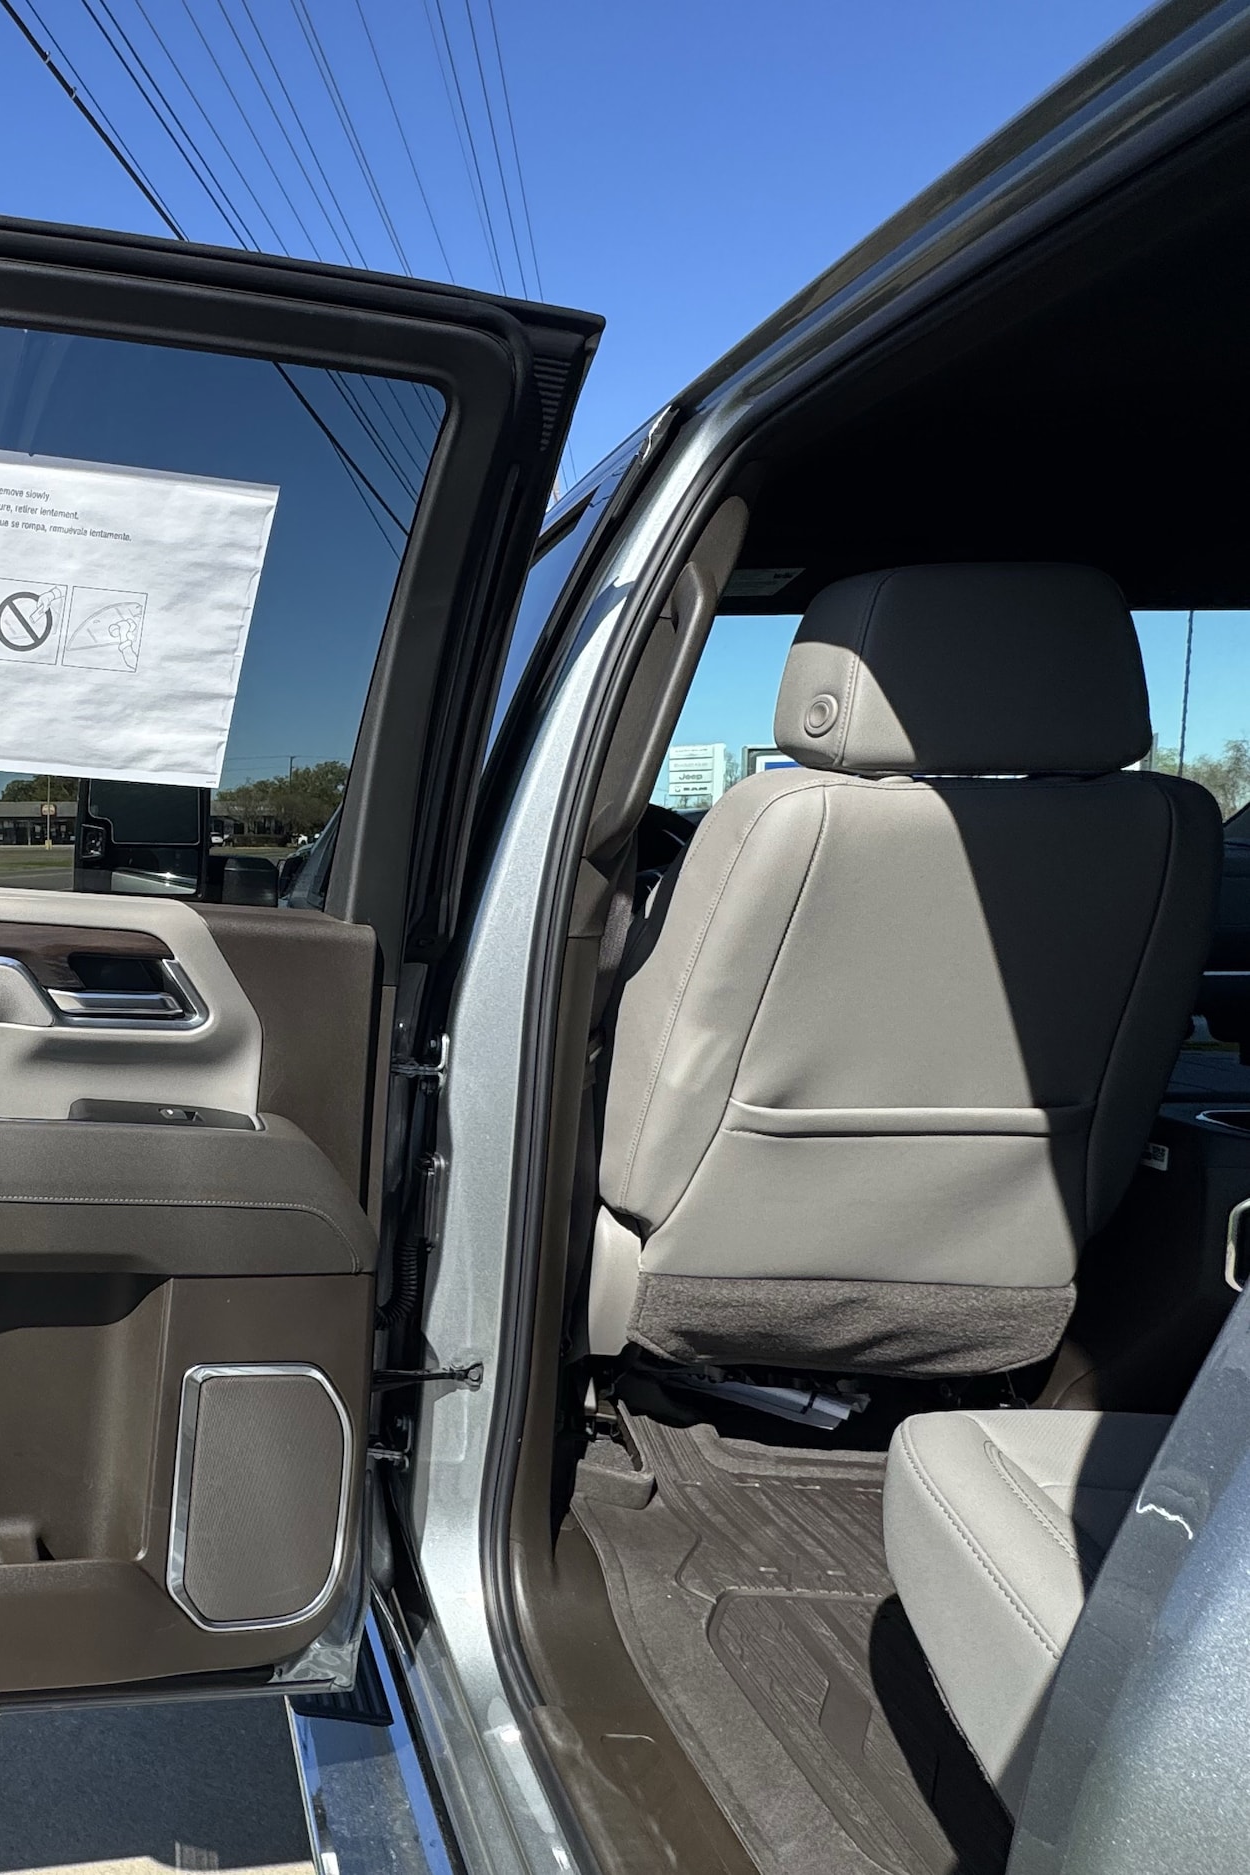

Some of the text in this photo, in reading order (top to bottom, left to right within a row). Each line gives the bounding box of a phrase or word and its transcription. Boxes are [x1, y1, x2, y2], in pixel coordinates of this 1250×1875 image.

[15, 504, 38, 515] retirer
[39, 506, 79, 520] lentement.
[11, 519, 20, 528] se
[21, 520, 47, 533] rompa,
[89, 528, 132, 542] lentamente.
